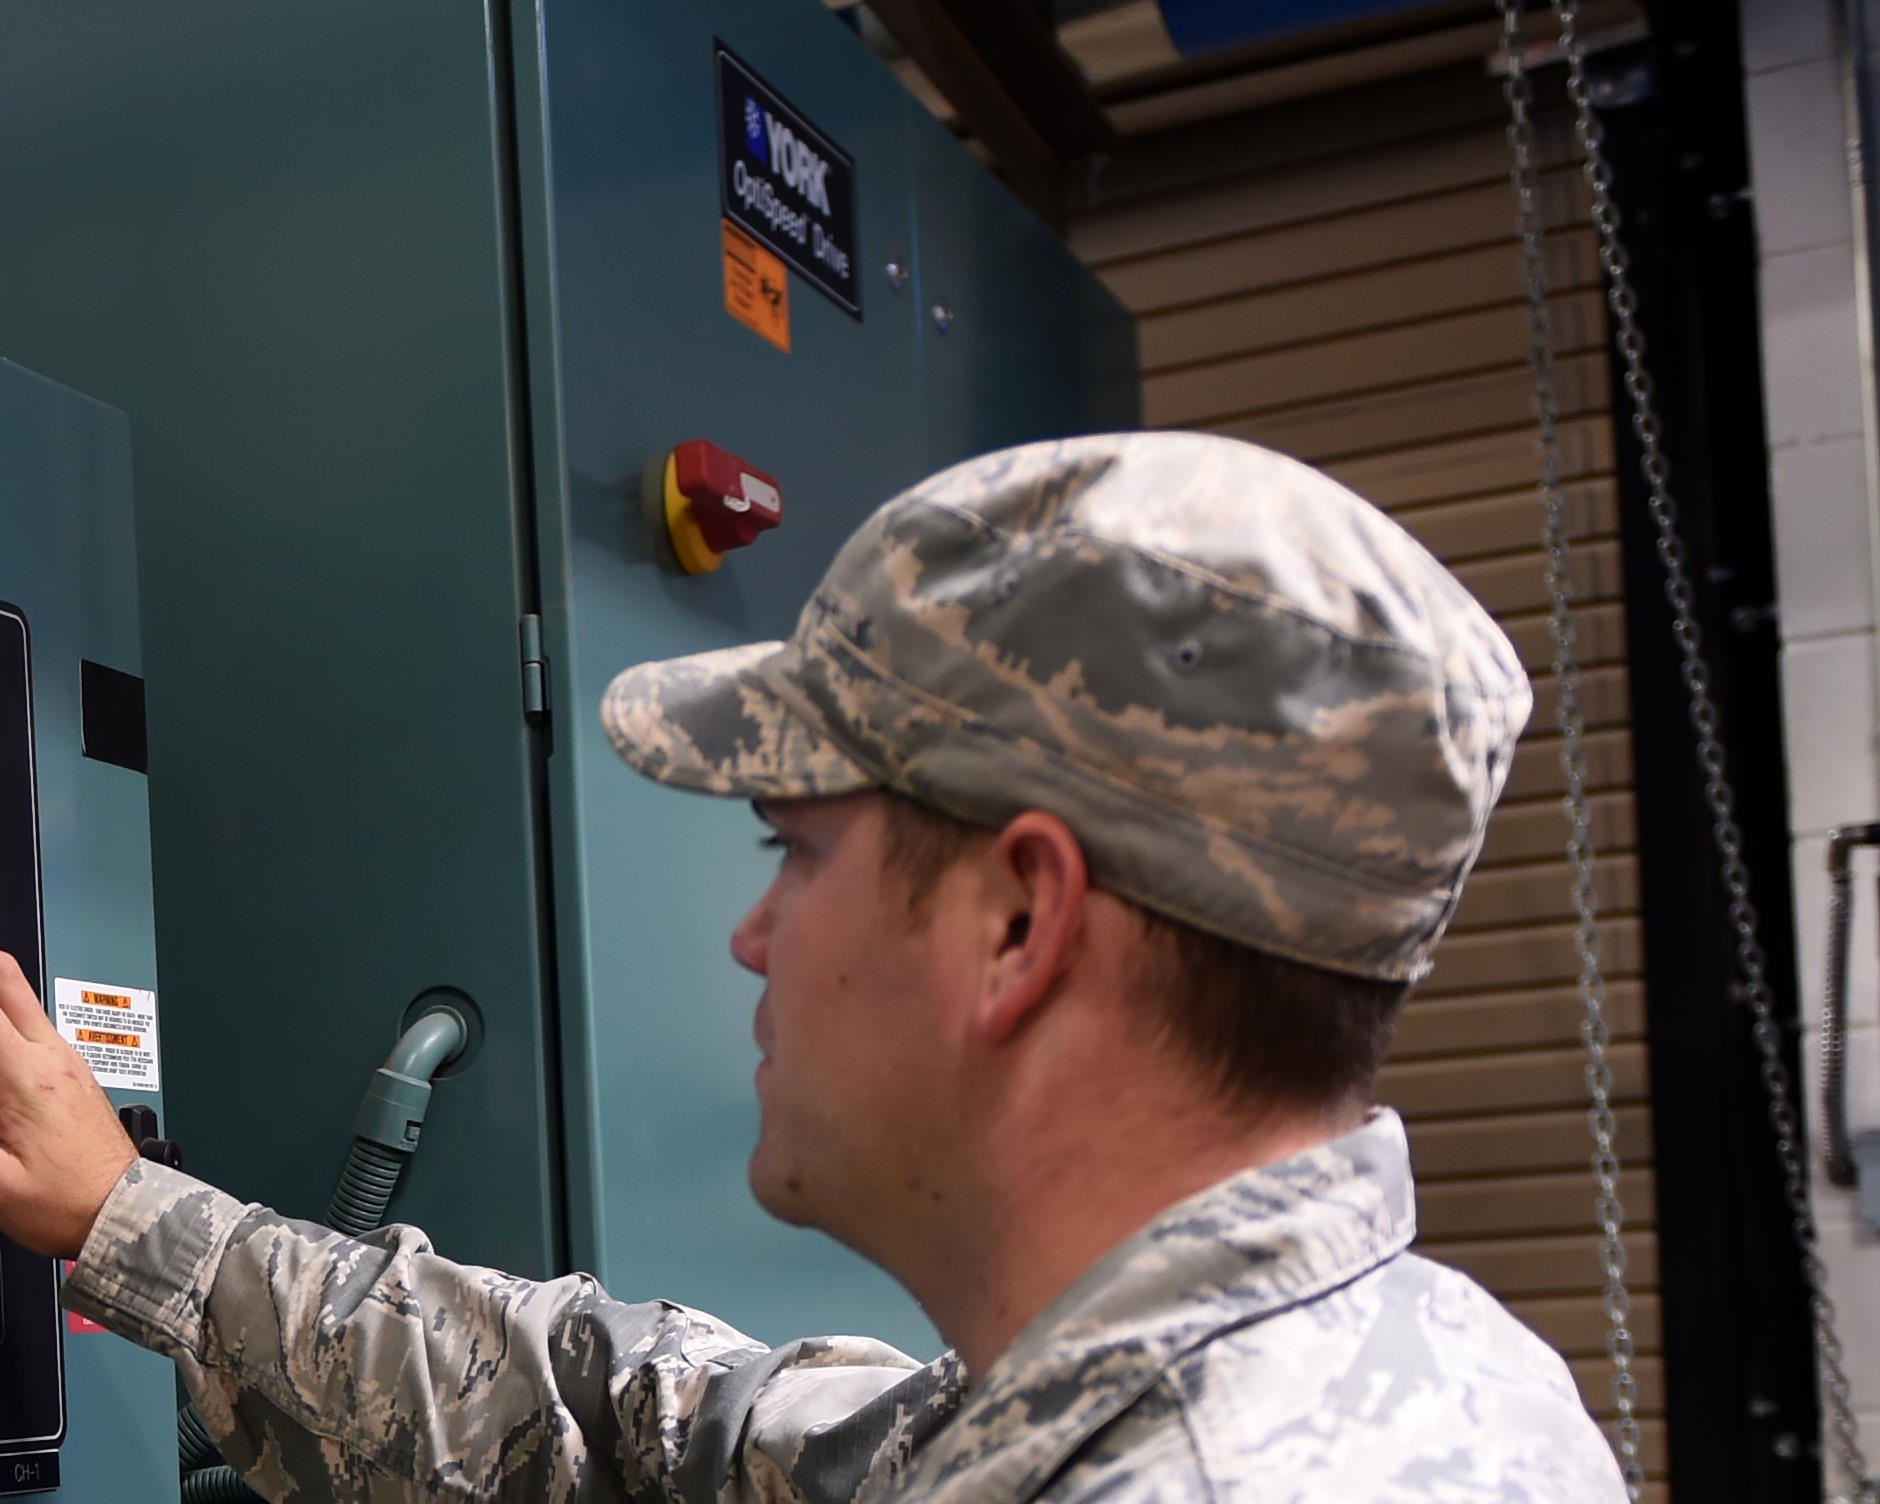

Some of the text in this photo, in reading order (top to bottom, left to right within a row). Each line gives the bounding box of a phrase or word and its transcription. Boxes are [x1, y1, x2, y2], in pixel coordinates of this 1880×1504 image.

[765, 111, 831, 217] YORK
[812, 223, 850, 280] Drive
[14, 1462, 39, 1483] CH-1
